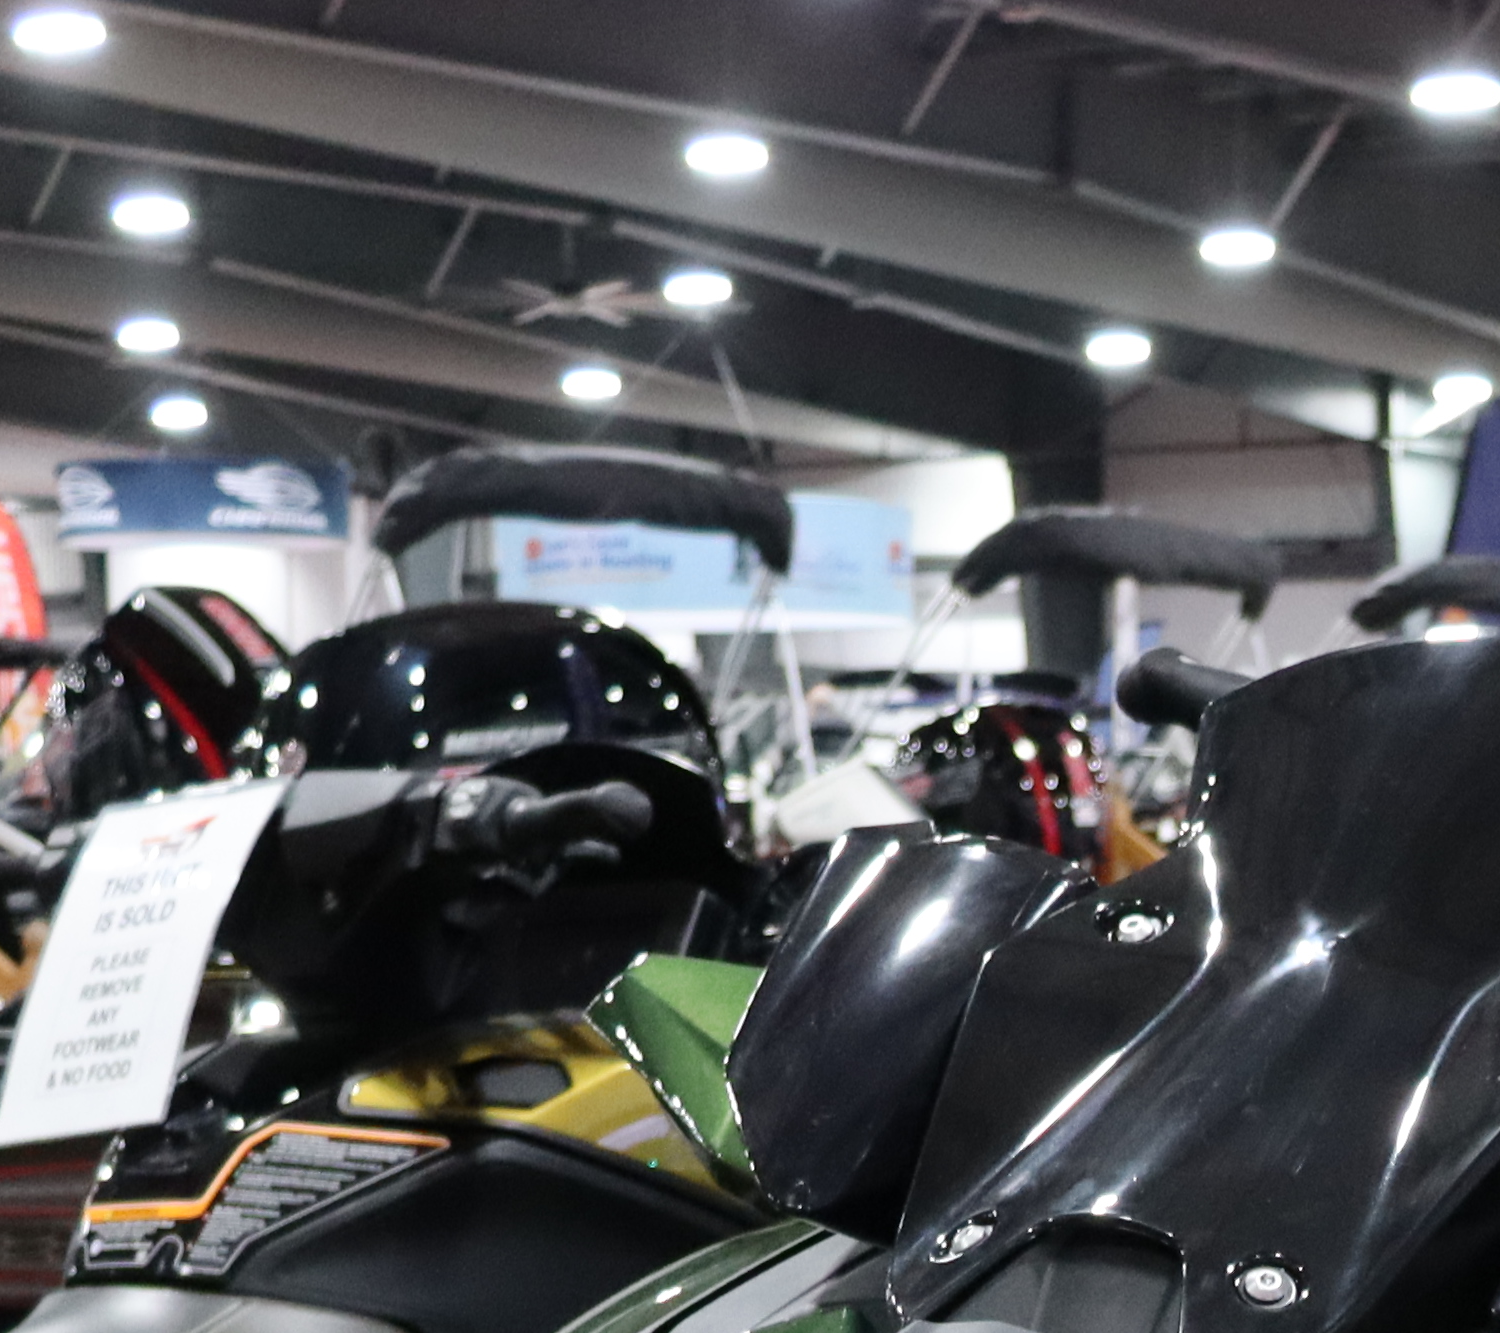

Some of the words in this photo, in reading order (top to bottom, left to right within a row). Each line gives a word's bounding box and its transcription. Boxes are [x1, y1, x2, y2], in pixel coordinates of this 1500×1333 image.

[102, 871, 148, 899] THIS
[94, 909, 115, 934] IS
[119, 899, 177, 930] SOLD
[90, 947, 151, 972] PLEASE
[78, 975, 146, 1002] REMOVE
[86, 1006, 120, 1029] ANY
[52, 1030, 141, 1059] FOOTWEAR
[60, 1066, 84, 1088] NO
[86, 1059, 132, 1084] FOOD
